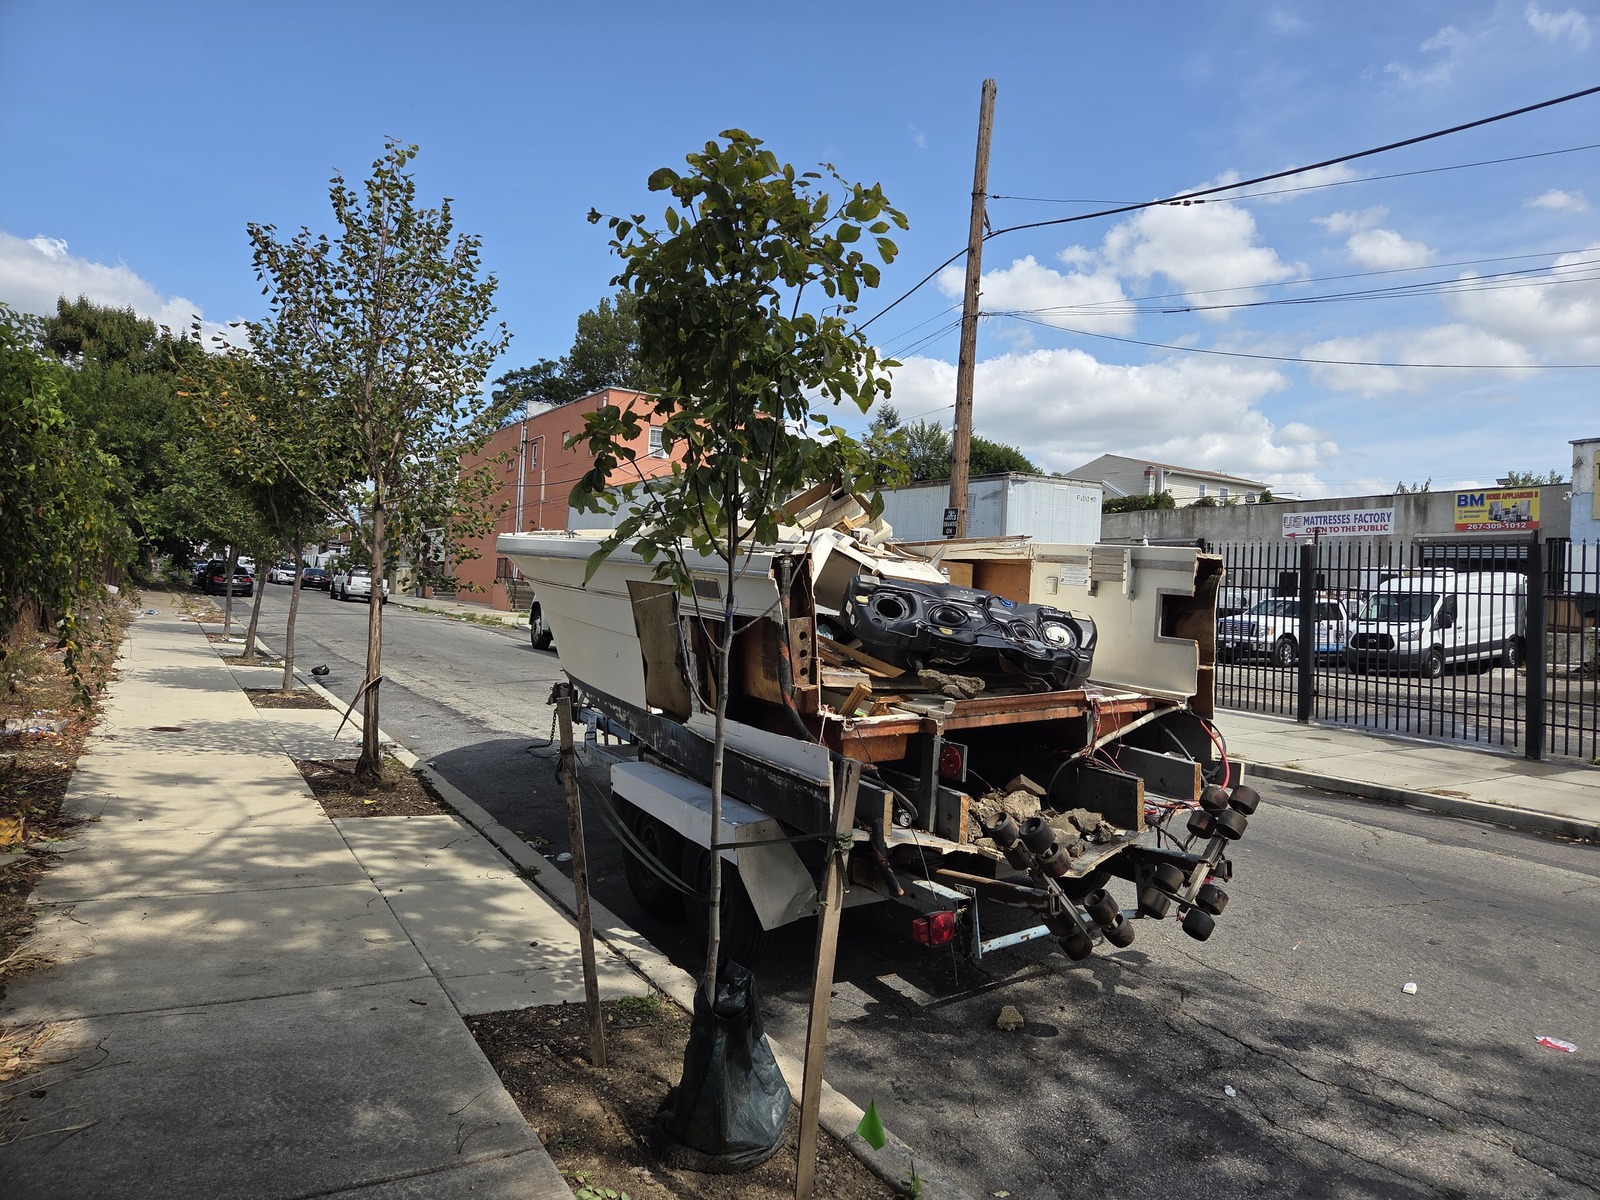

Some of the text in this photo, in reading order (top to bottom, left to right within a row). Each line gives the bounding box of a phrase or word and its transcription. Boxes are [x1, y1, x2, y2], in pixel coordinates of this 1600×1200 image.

[1457, 493, 1485, 507] BM
[1303, 514, 1351, 526] MATTRESSES
[1354, 512, 1392, 523] FACTORY
[1341, 525, 1356, 533] THE
[1358, 524, 1389, 532] PUBLIC
[1467, 522, 1527, 530] 267-309-1012
